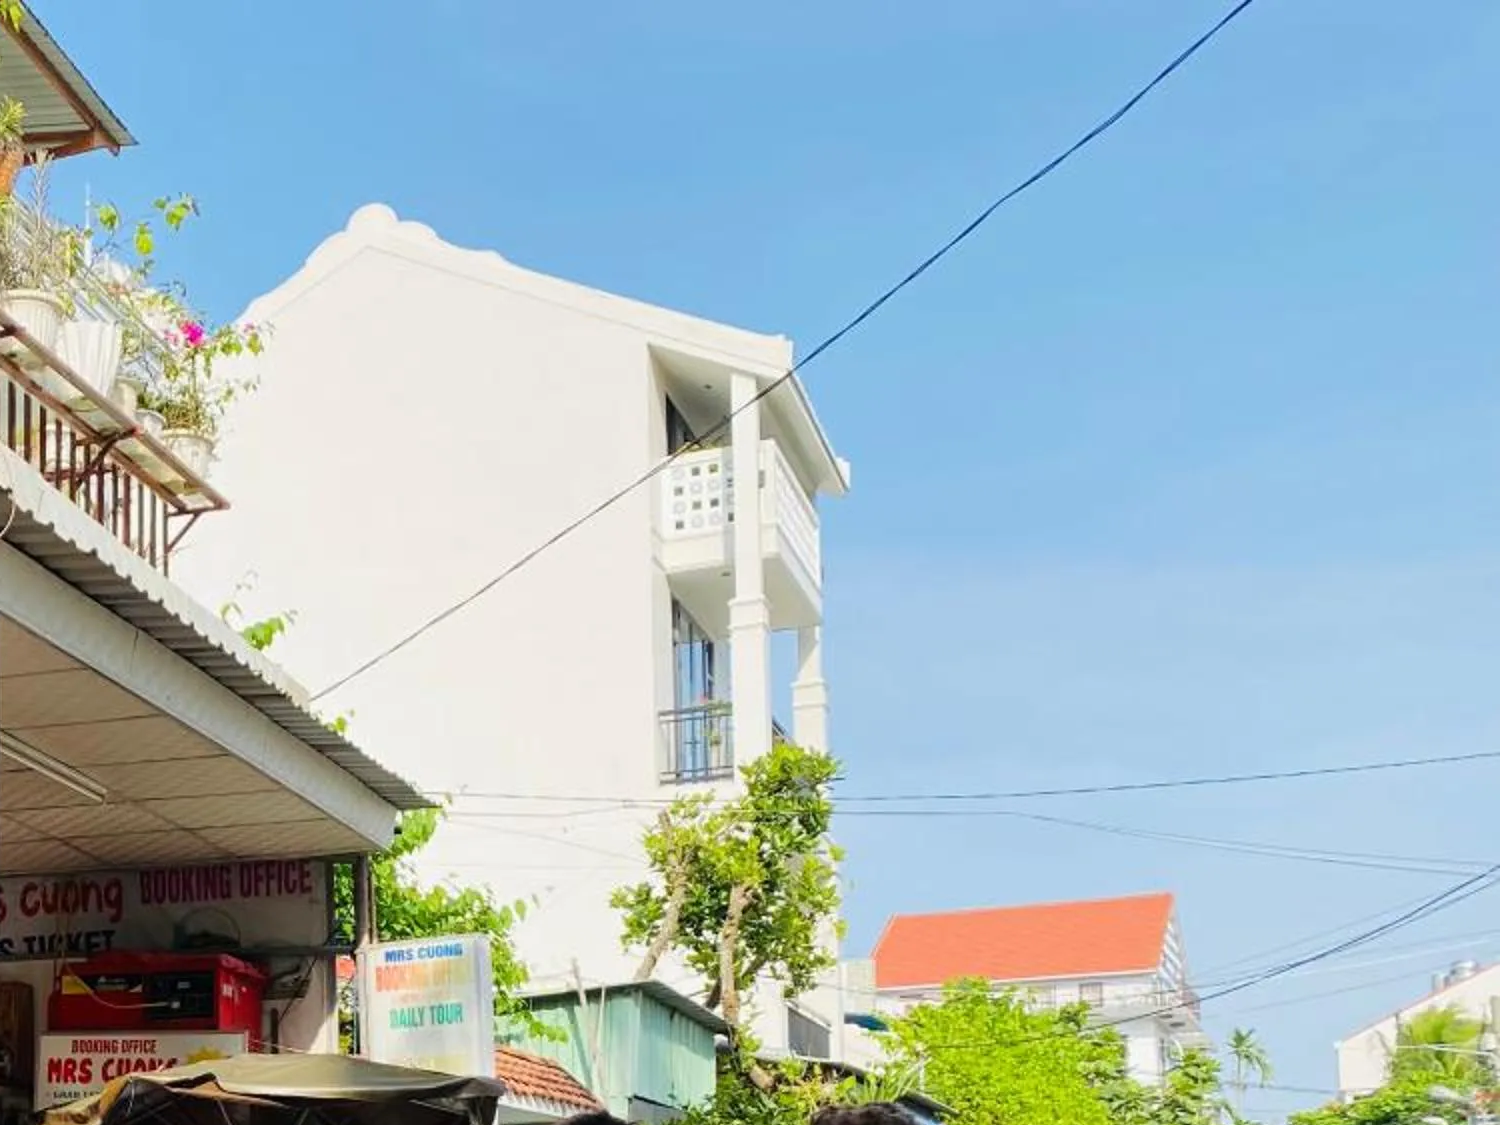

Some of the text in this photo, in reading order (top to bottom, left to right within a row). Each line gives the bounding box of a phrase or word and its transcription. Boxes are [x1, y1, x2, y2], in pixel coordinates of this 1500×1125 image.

[138, 858, 312, 905] BOOKING OFFICE
[389, 1003, 463, 1029] DAILY TOUR
[71, 1039, 157, 1054] BOOKING OFFICE
[47, 1057, 93, 1085] MRS
